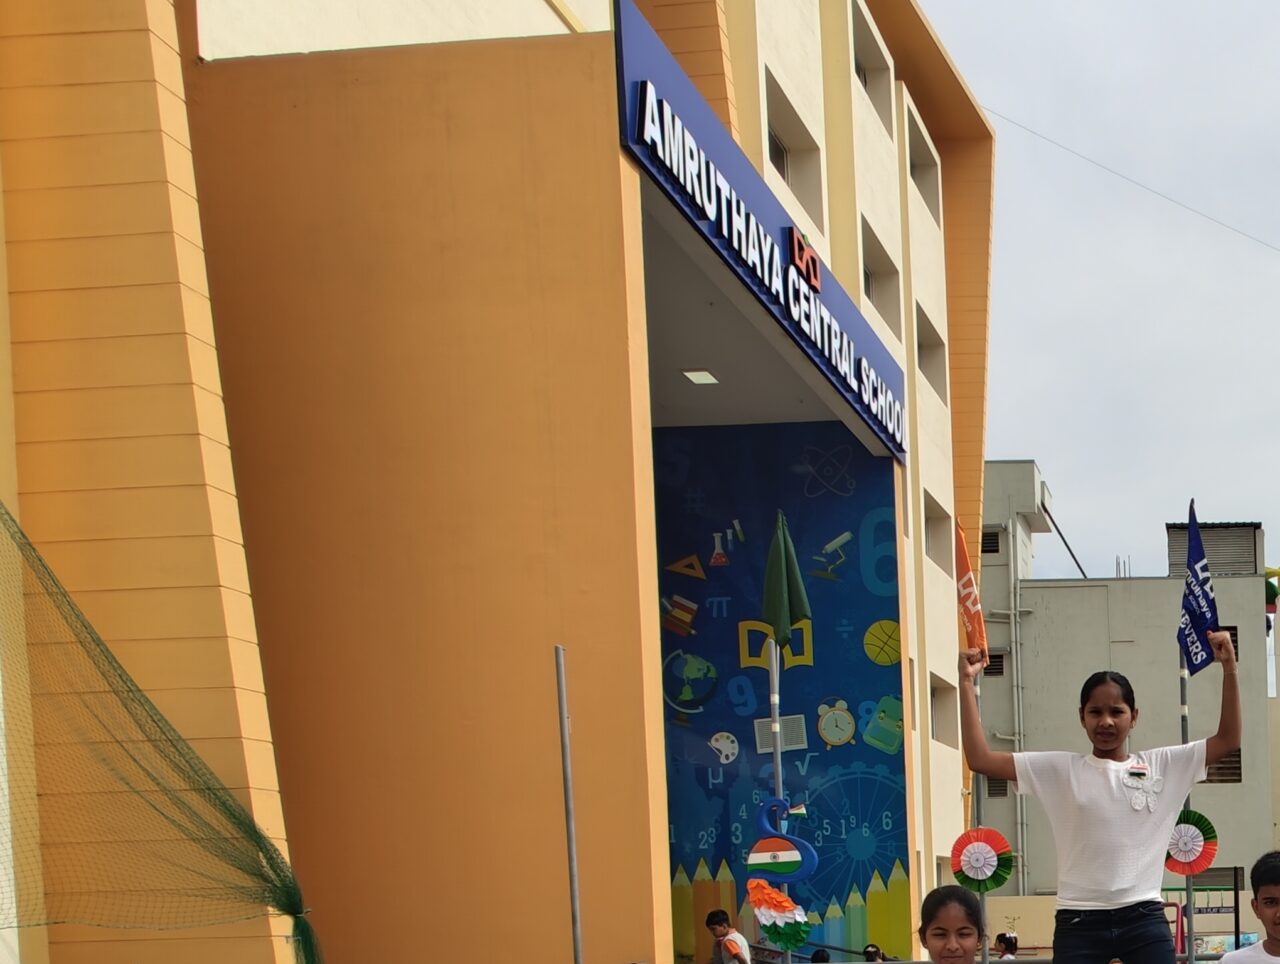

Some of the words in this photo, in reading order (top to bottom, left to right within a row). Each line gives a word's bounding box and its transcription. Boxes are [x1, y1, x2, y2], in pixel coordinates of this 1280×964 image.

[643, 80, 785, 306] AMRUTHAYA
[788, 264, 859, 394] CENTRAL
[727, 675, 758, 716] 9
[882, 811, 893, 831] 6
